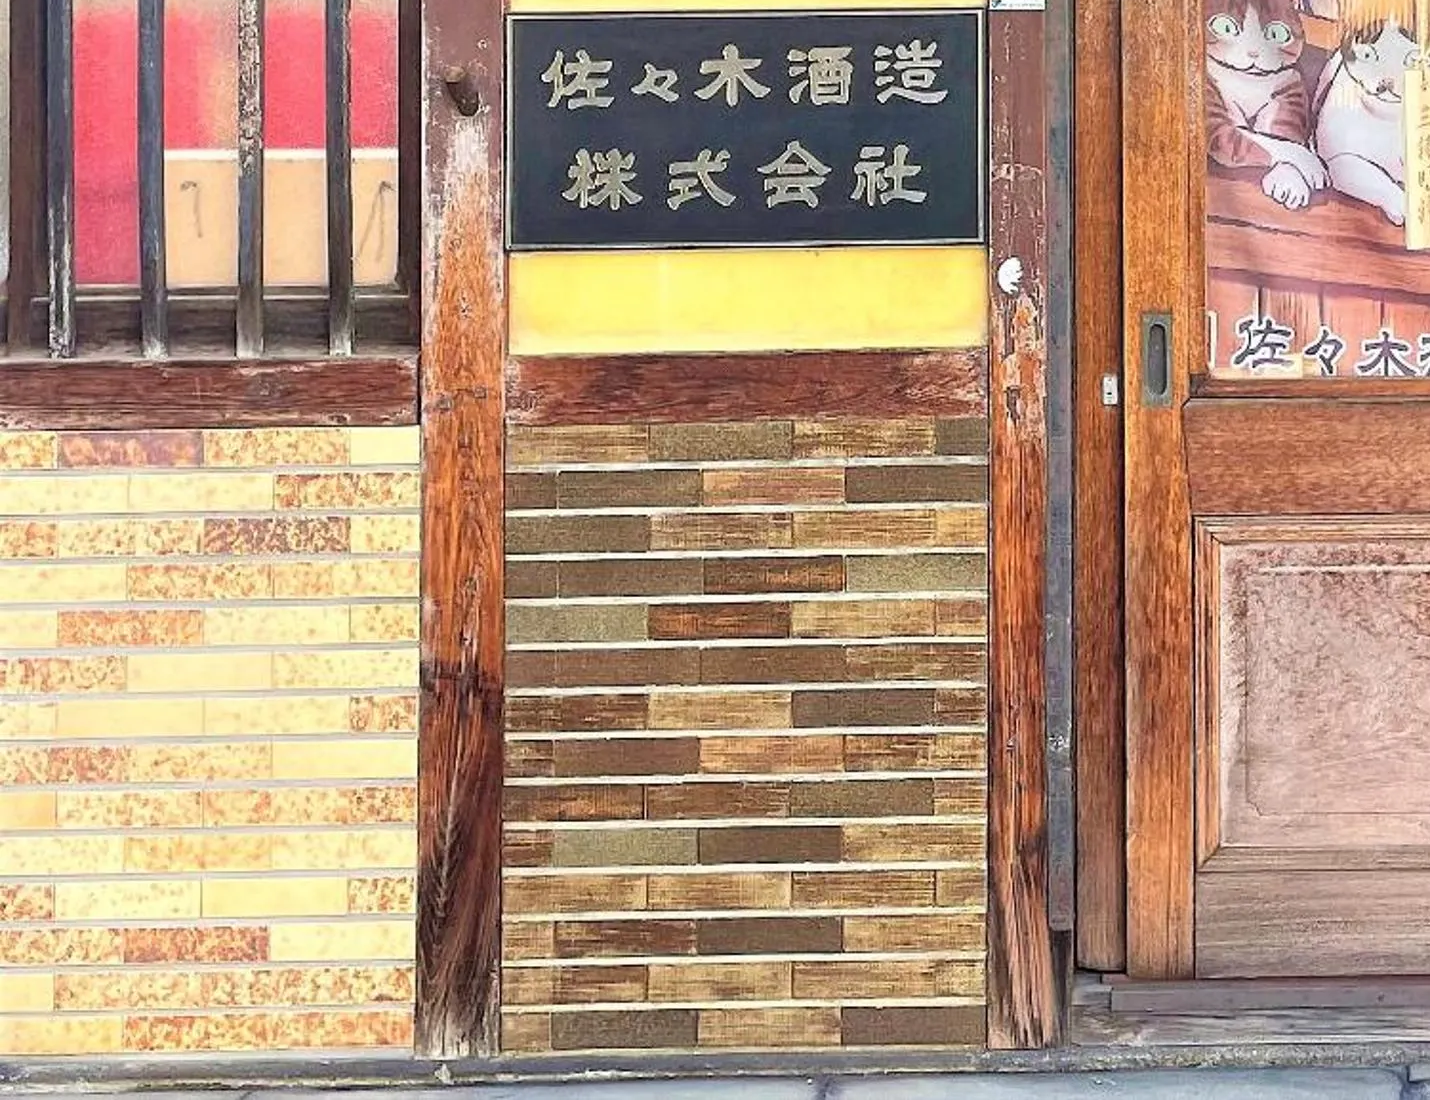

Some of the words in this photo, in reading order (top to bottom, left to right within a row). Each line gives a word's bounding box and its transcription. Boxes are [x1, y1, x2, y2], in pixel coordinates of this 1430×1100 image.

[540, 39, 950, 109] 佐々木酒造
[560, 140, 928, 211] 株式会社
